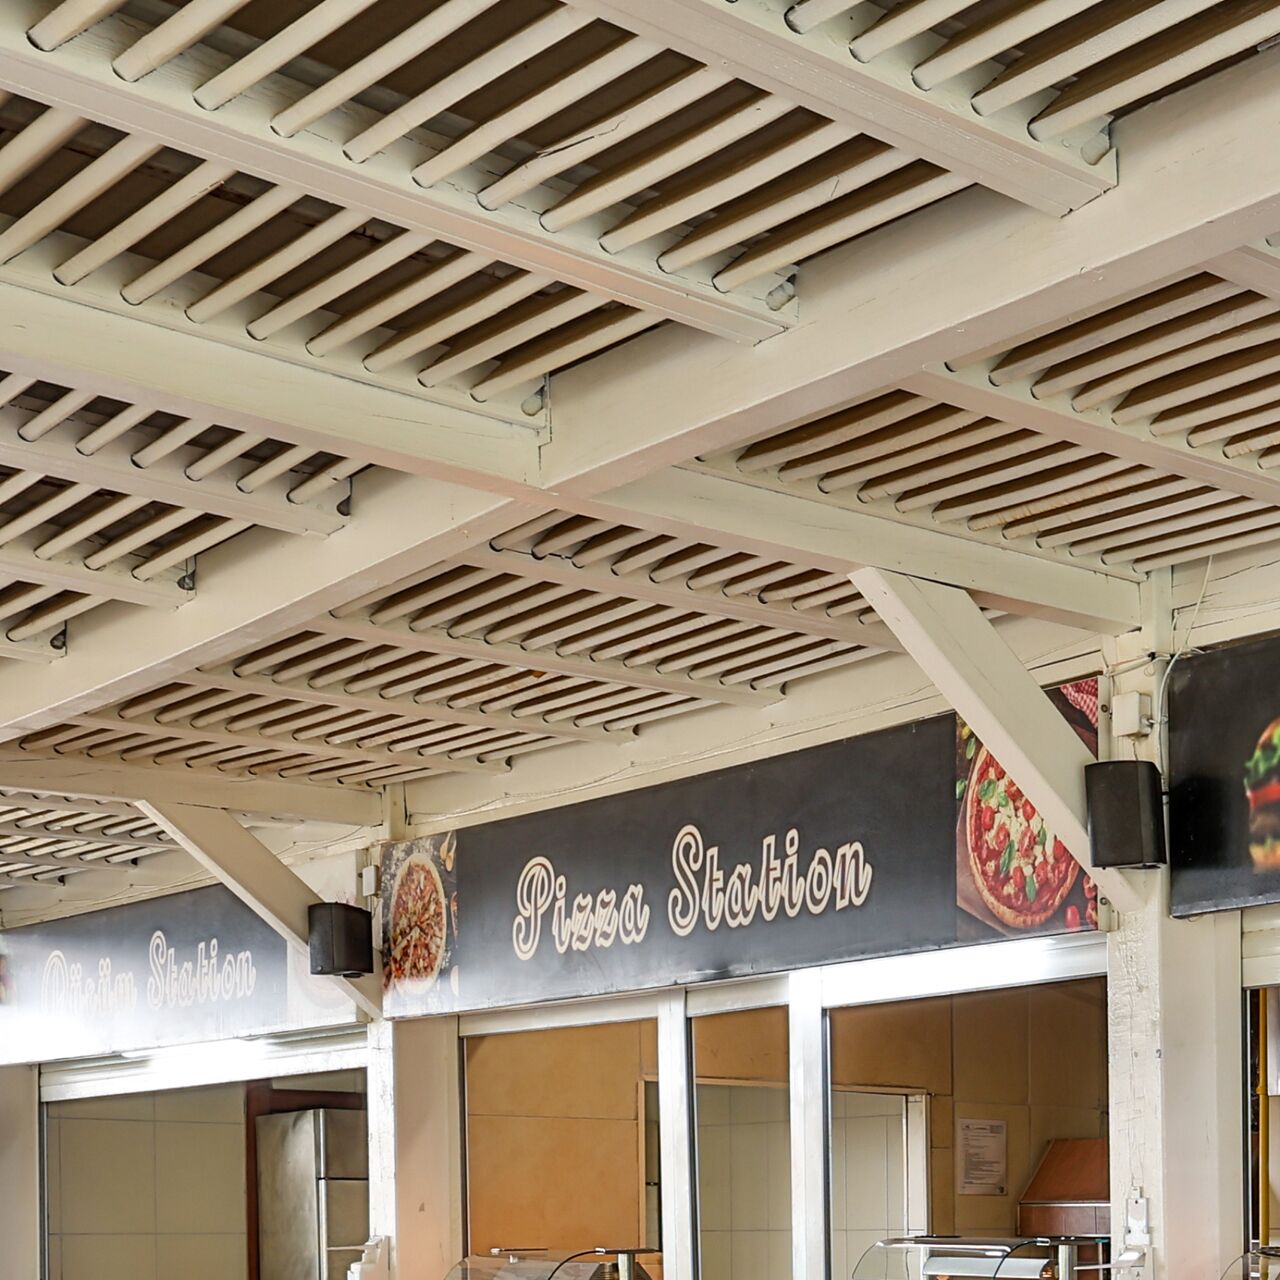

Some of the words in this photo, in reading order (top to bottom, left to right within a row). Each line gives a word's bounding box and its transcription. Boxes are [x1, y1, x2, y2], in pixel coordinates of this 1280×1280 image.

[513, 856, 649, 960] Pizza
[668, 824, 873, 936] Station
[147, 930, 257, 1008] Station
